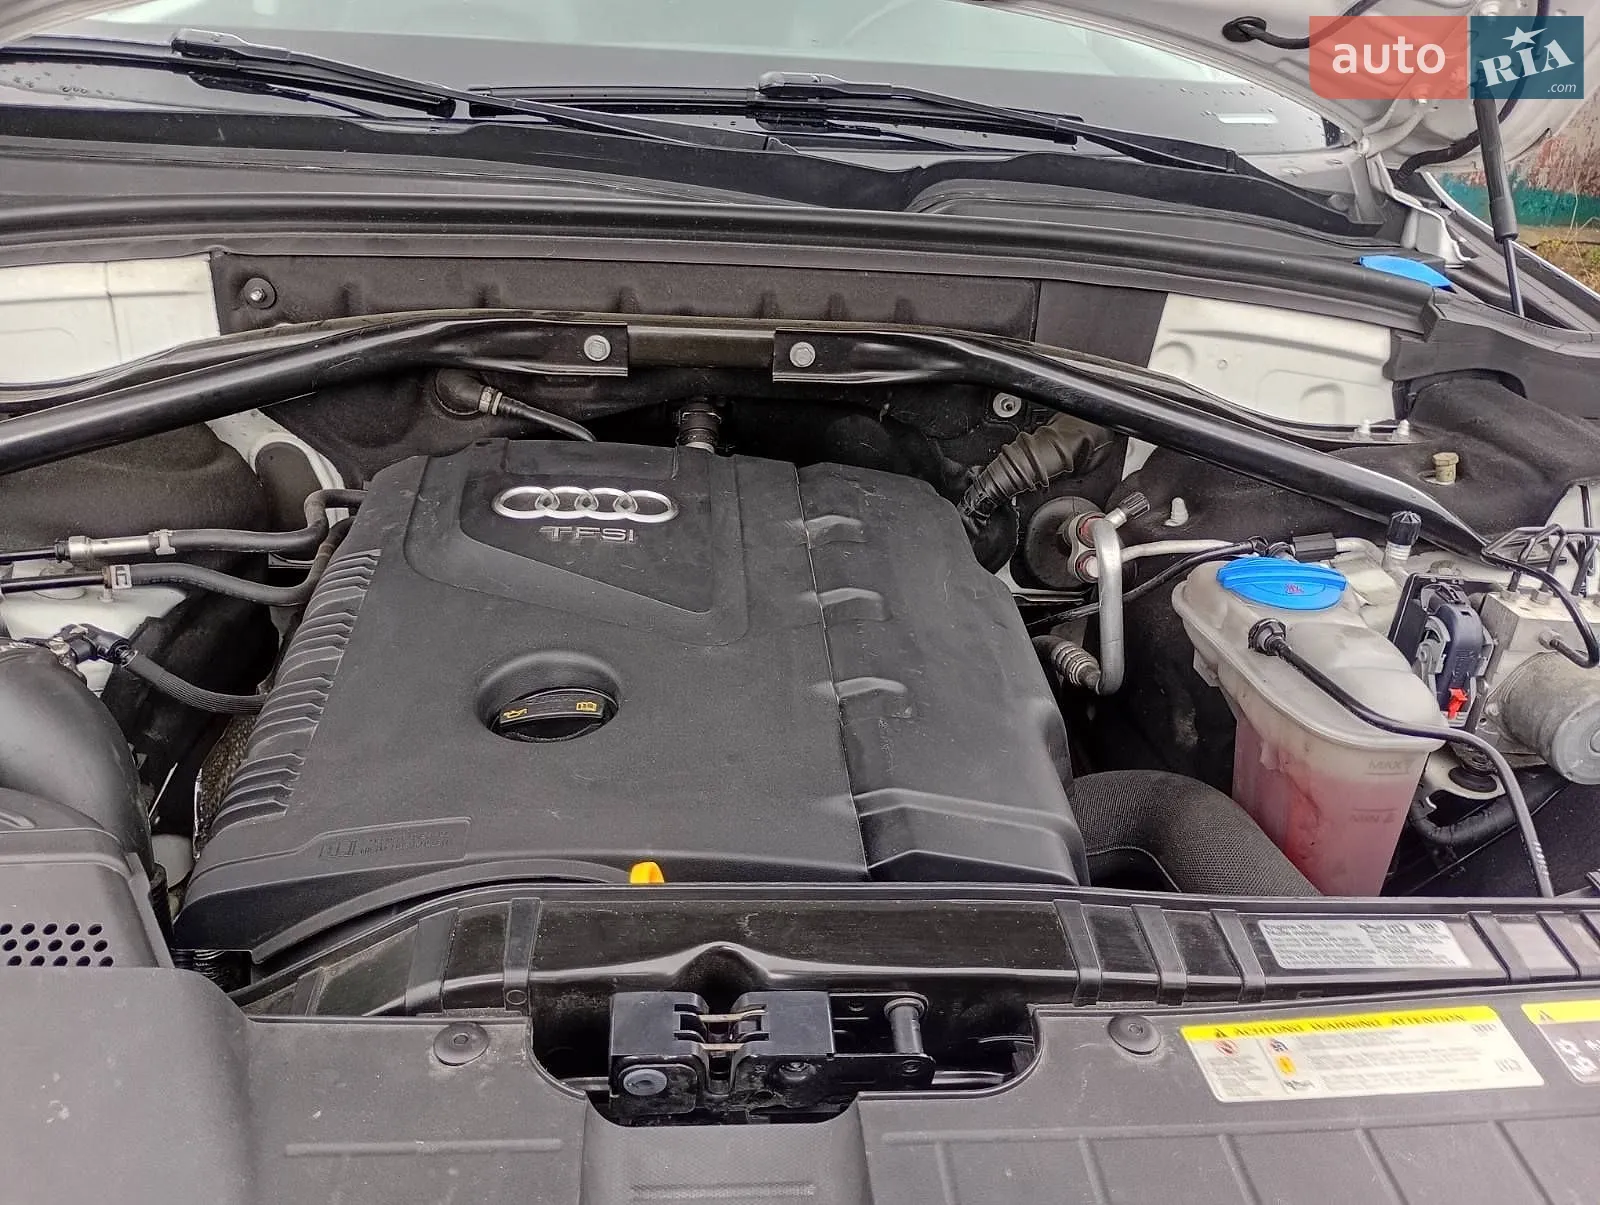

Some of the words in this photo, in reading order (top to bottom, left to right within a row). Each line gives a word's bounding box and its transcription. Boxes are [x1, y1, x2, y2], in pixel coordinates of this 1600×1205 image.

[540, 526, 635, 543] TFSI
[1235, 1024, 1304, 1037] ACHTUNG
[1309, 1017, 1383, 1032] WARNING
[1391, 1013, 1467, 1026] ATTENTION
